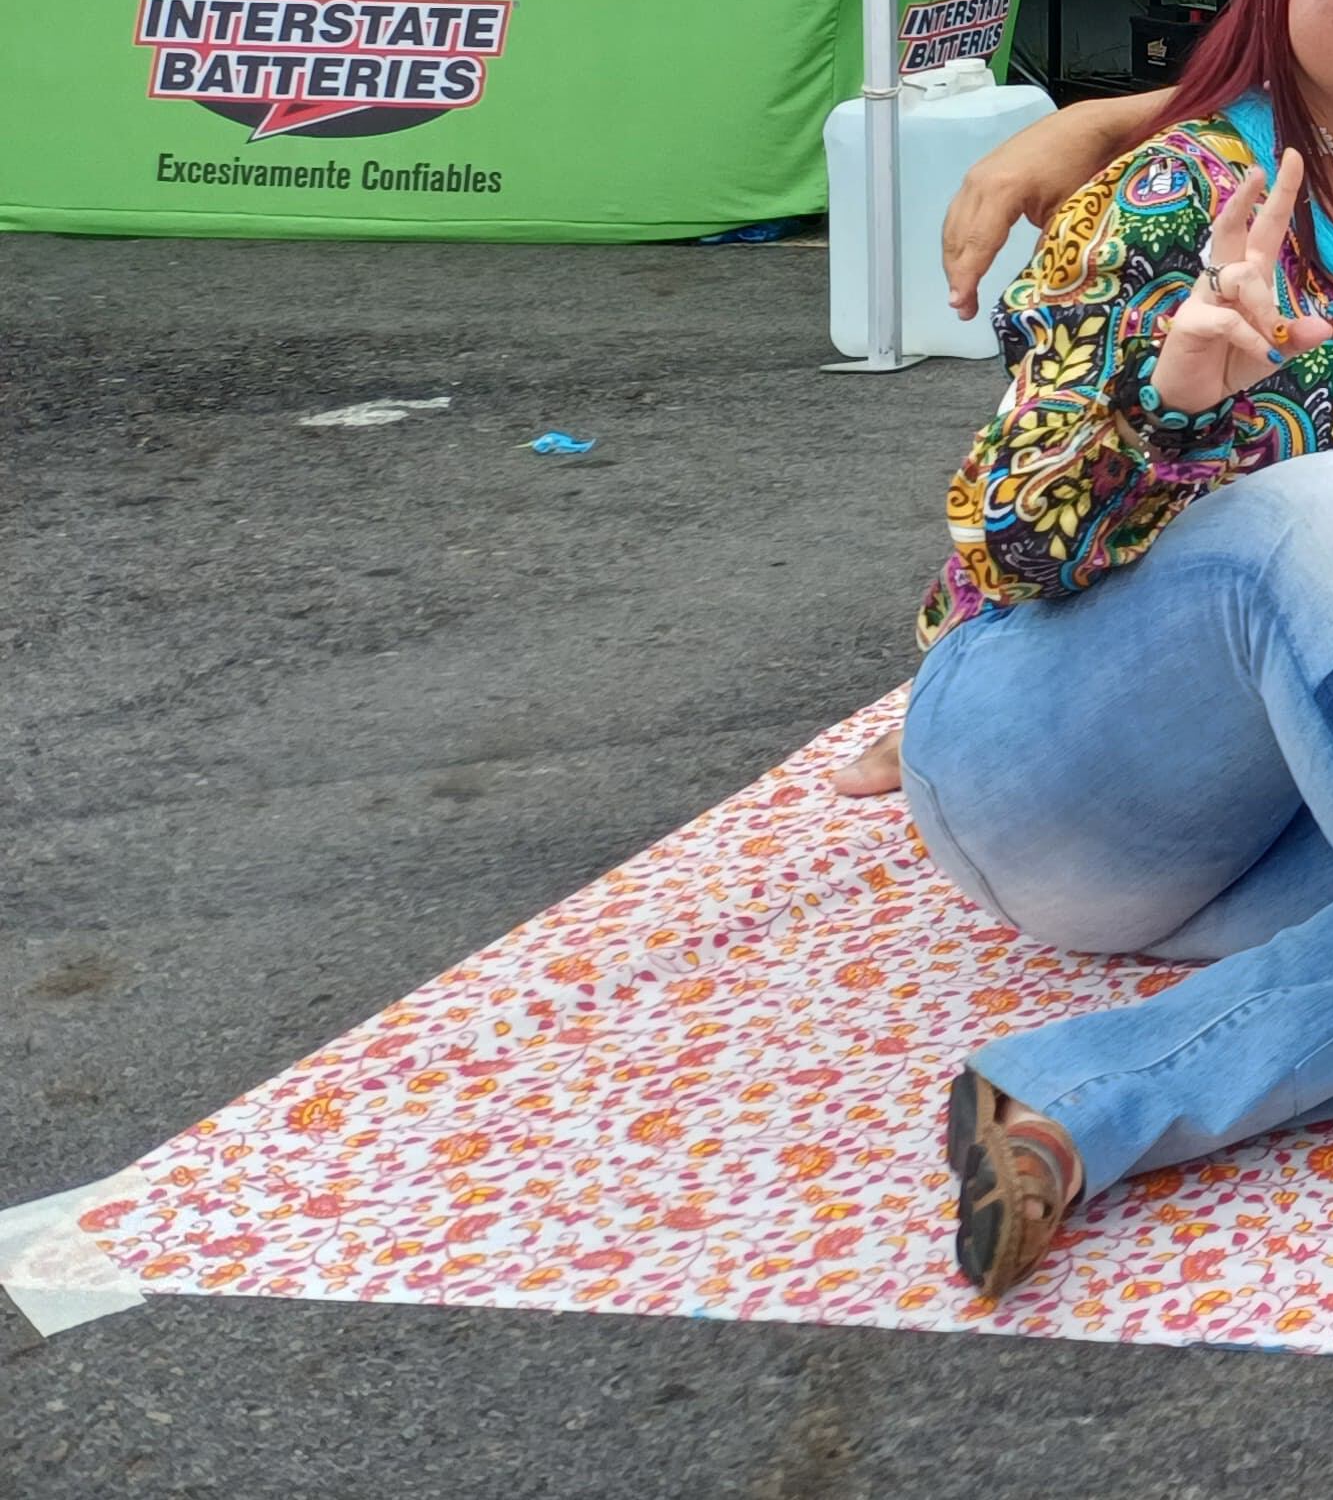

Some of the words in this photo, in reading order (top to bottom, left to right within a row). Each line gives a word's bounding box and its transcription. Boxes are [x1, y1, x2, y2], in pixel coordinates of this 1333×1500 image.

[906, 23, 1003, 69] BATTERIES
[159, 52, 477, 100] BATTERIES
[157, 153, 350, 190] Excesivamente
[362, 160, 501, 193] Confiables
